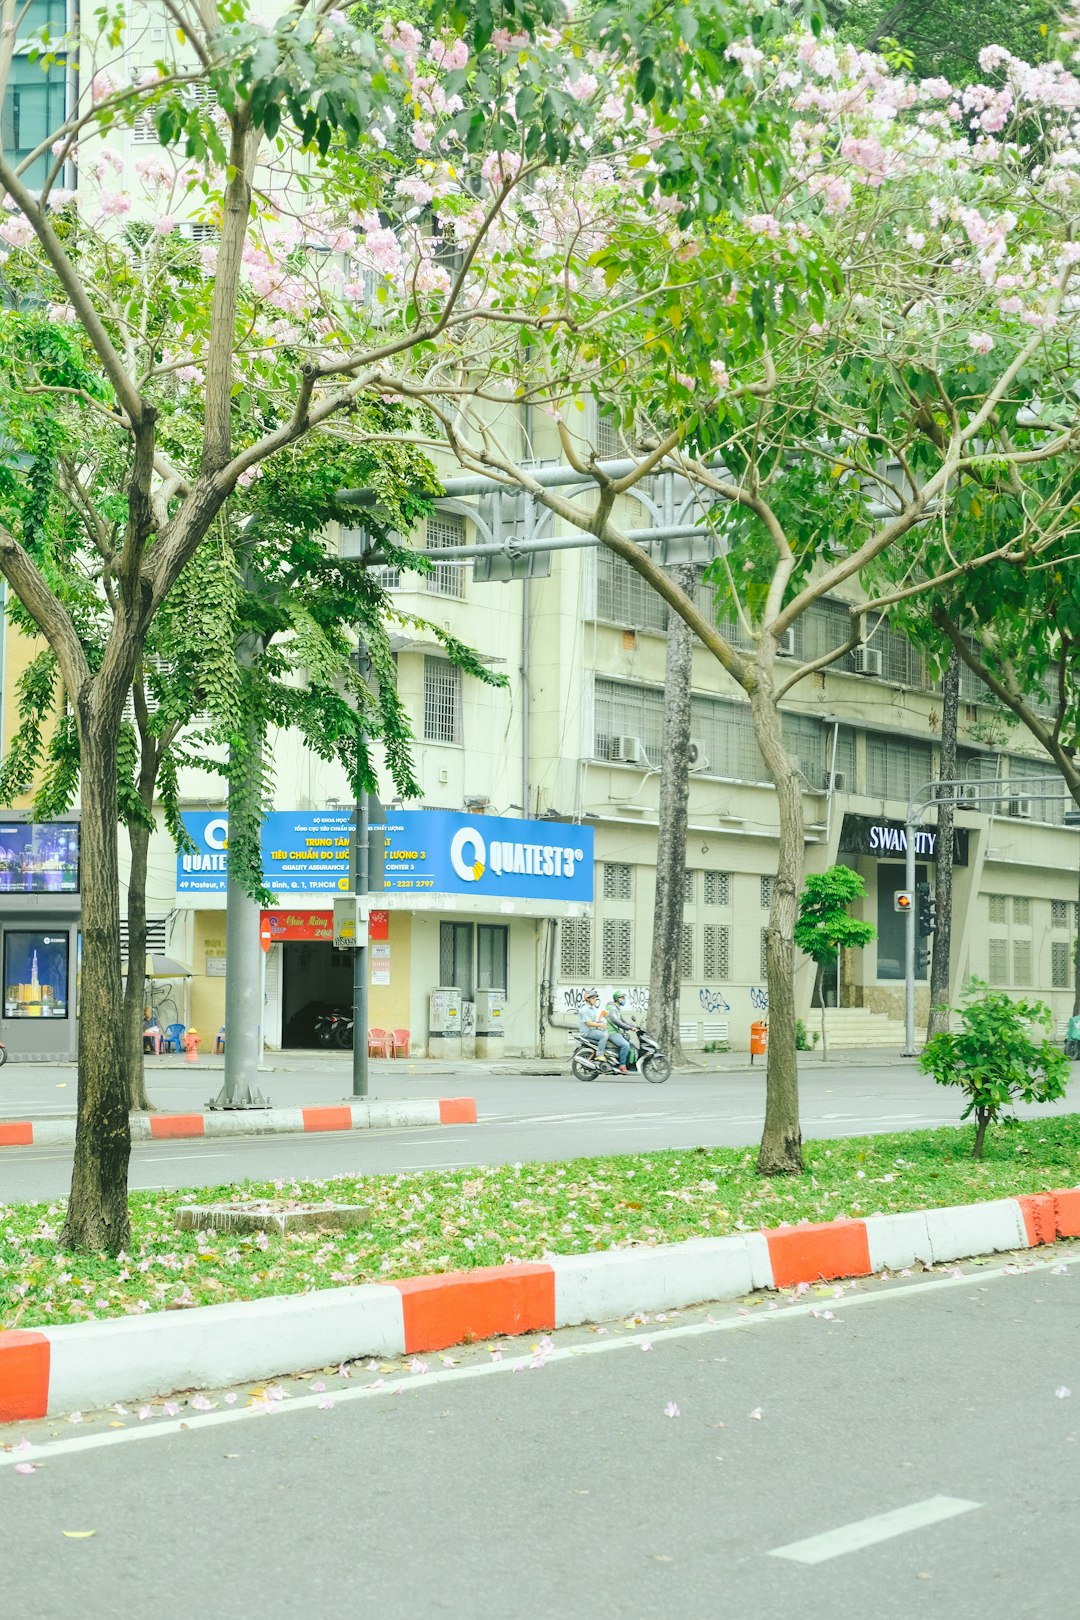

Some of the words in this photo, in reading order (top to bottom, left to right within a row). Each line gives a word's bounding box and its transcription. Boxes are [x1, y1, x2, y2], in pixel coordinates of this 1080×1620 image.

[305, 838, 332, 846] TRUNG
[870, 826, 936, 854] SWANITY
[271, 850, 287, 860] TIÊU
[289, 847, 318, 860] CHUẨN
[390, 850, 418, 861] LƯỢNG
[272, 880, 289, 888] Bình,
[315, 929, 332, 937] 202
